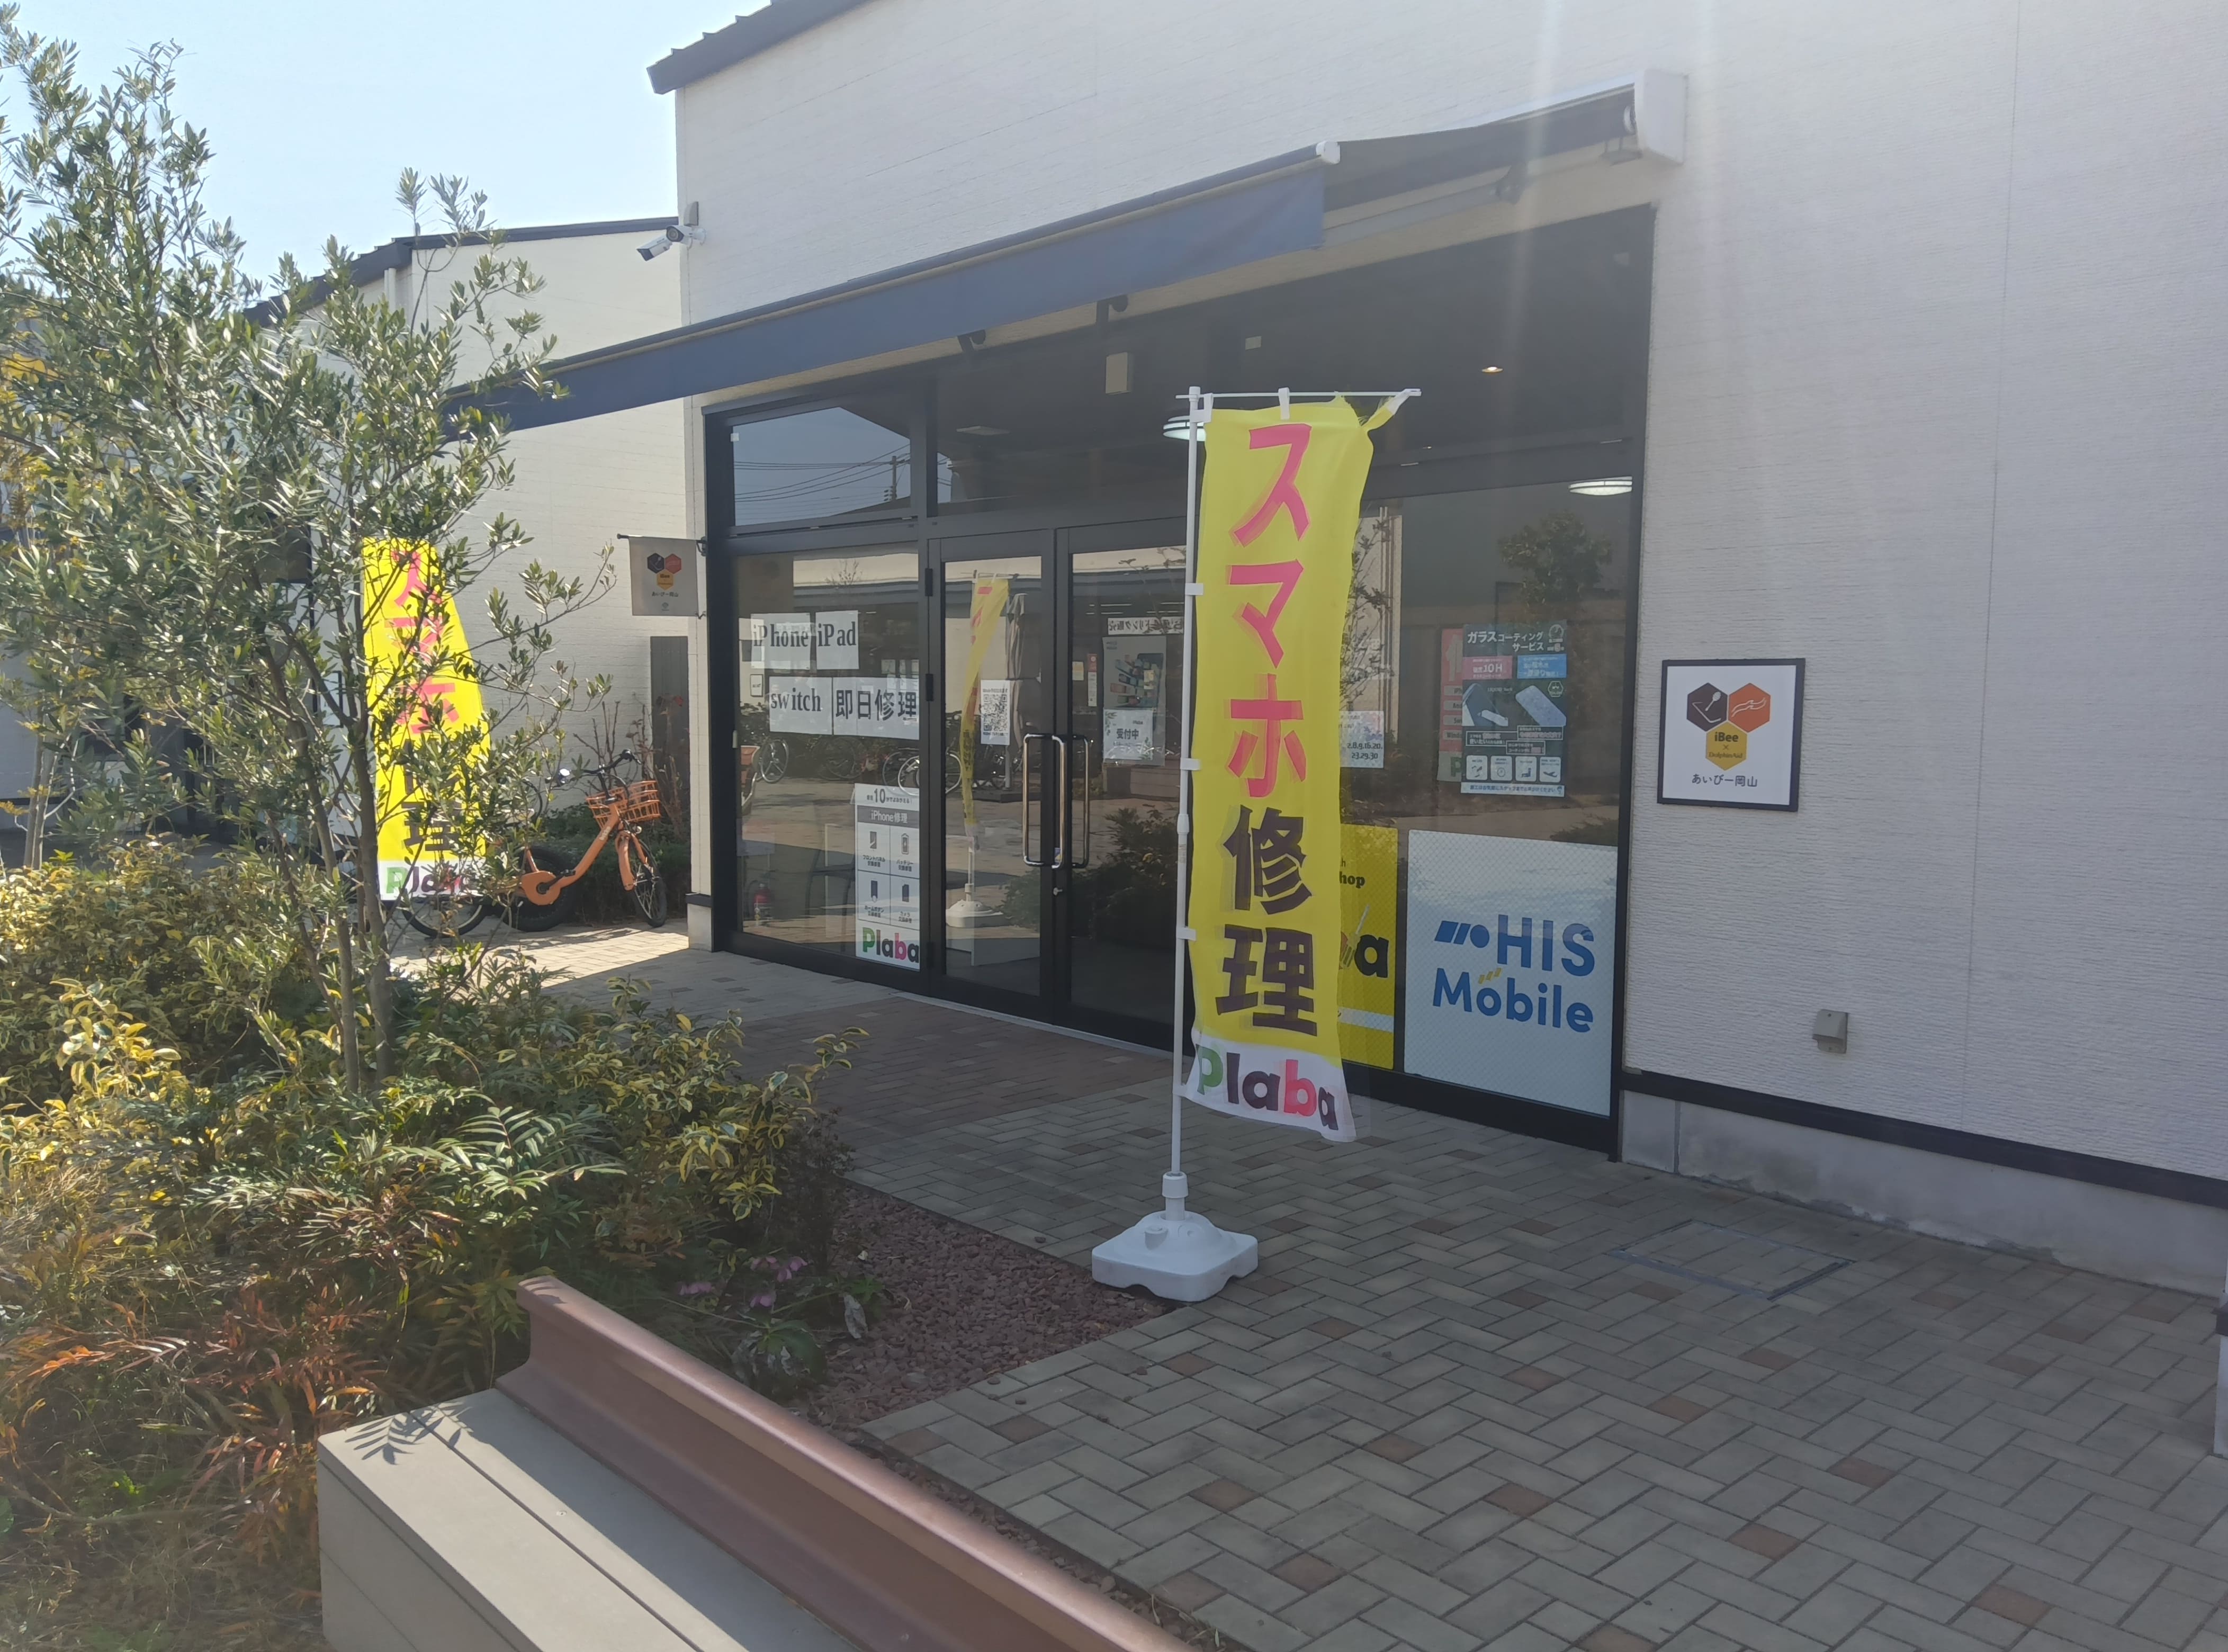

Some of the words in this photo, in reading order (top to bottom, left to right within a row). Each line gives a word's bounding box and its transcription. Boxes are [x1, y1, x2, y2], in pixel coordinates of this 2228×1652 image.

[753, 623, 809, 647] iPhone
[817, 621, 857, 647] iPad
[1467, 631, 1543, 644] ガラスコーティング
[1512, 642, 1544, 652] サービス
[771, 688, 821, 712] switch
[836, 689, 917, 721] 即日修理
[1116, 728, 1139, 740] 受付中
[1216, 423, 1317, 1037] スマホ修理
[1714, 731, 1739, 742] iBee
[1692, 773, 1758, 787] あいびー岡山
[870, 809, 908, 824] iPhone修理
[1339, 870, 1365, 889] hop
[863, 927, 919, 964] Plaba
[1497, 914, 1595, 976] HIS
[1432, 967, 1594, 1033] Mobile
[1195, 1043, 1339, 1131] Plaba
